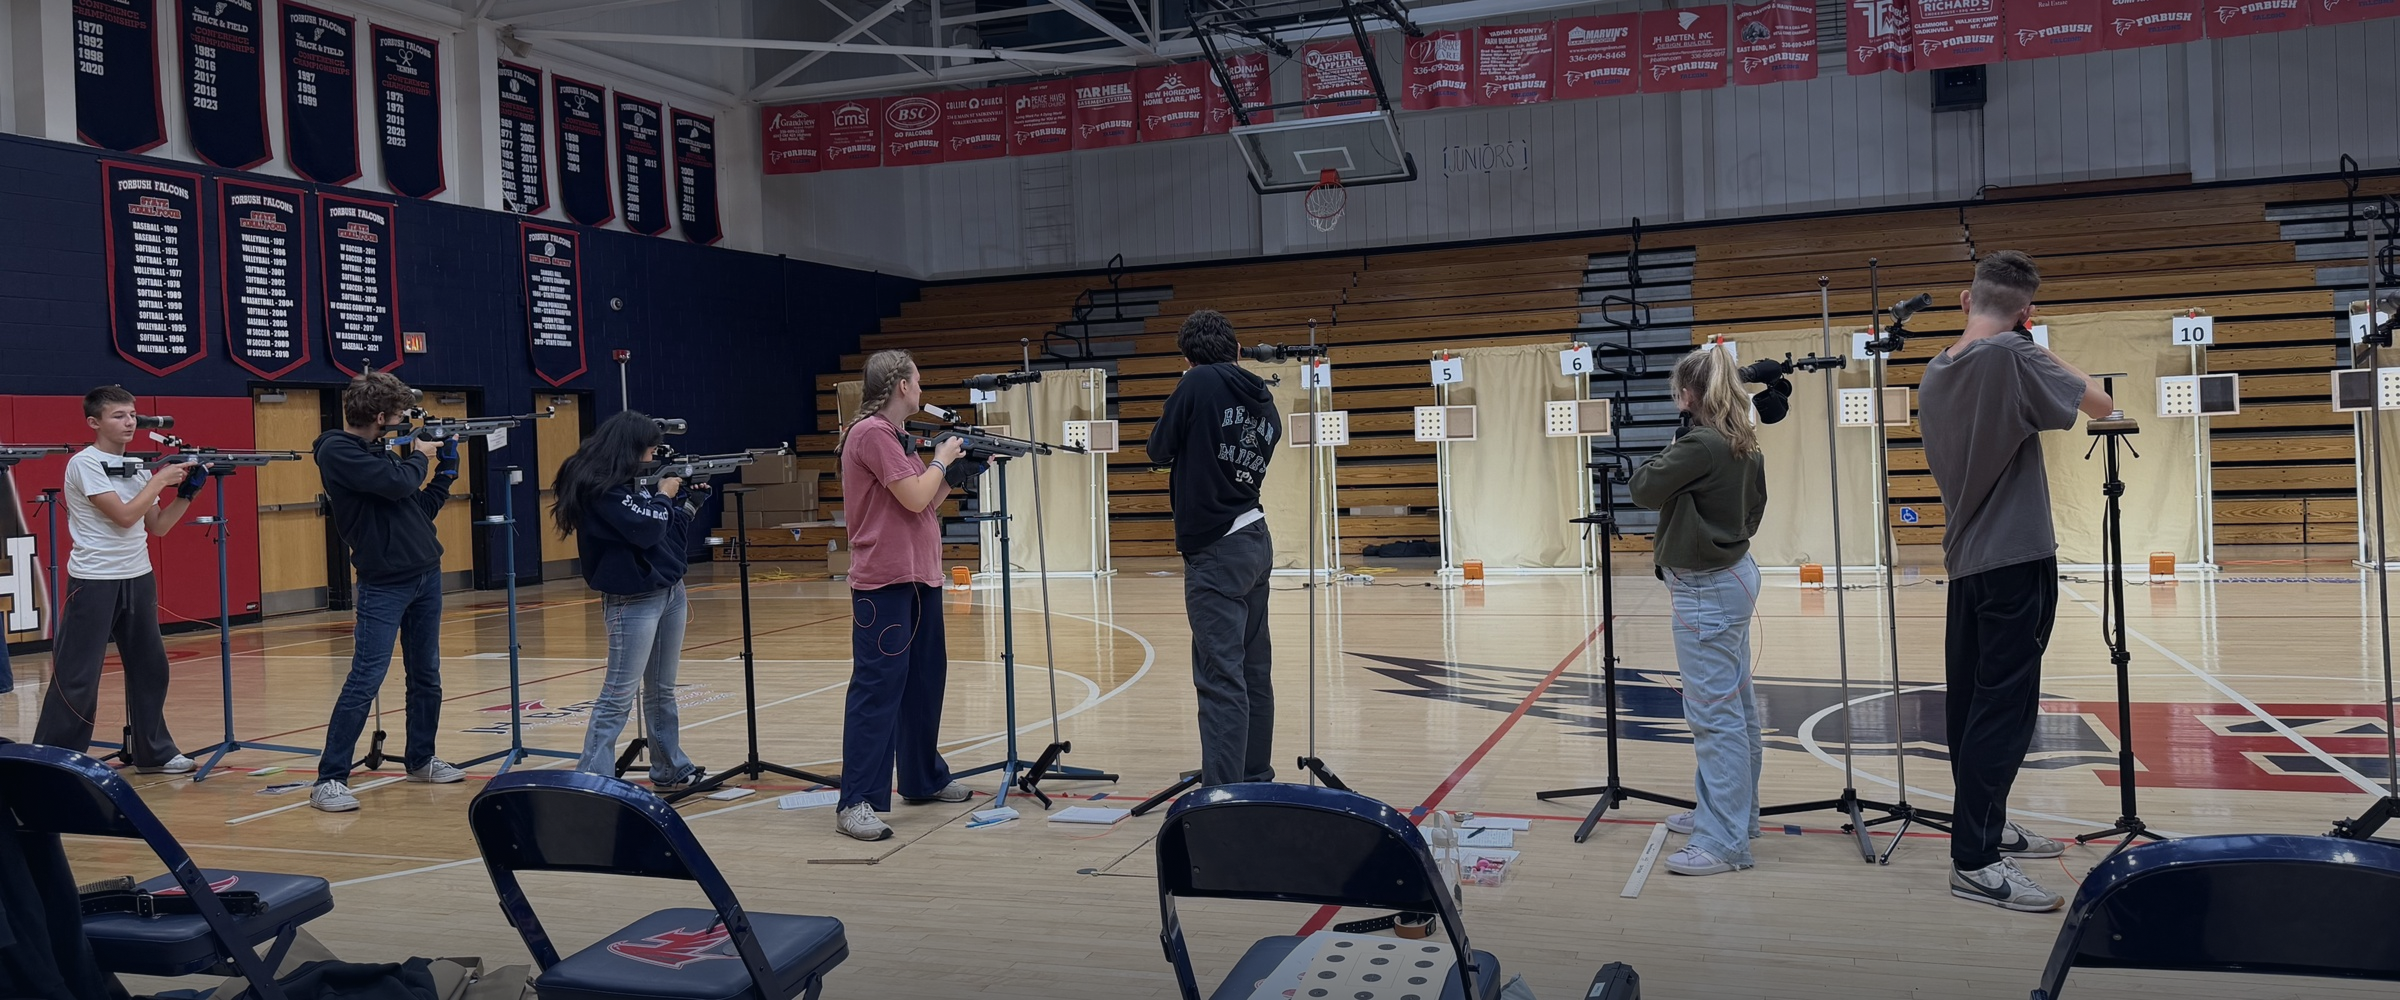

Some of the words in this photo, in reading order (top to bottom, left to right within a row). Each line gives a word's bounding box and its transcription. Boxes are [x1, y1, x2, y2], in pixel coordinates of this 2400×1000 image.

[79, 0, 139, 20] CONFERENCE
[1753, 4, 1771, 15] PAVING
[1776, 4, 1813, 14] MAINTENANCE
[2240, 0, 2298, 15] FORBUSH
[73, 6, 147, 30] CHAMPIONSHIPS
[192, 12, 218, 26] TRACK
[219, 20, 225, 28] &
[227, 21, 248, 33] FIELD
[1914, 21, 1948, 29] CLEMMONS
[1955, 16, 1998, 24] WALKERTOWN
[2136, 12, 2192, 27] FORBUSH
[2252, 12, 2286, 21] FALCONS
[77, 19, 103, 36] 1970
[290, 14, 317, 25] FORBUSH
[318, 17, 346, 37] FALCONS
[1915, 26, 1954, 35] YADKINVILLE
[2038, 24, 2093, 38] FORBUSH
[2148, 24, 2182, 33] FALCONS
[195, 26, 249, 45] CONFERENCE
[1519, 33, 1547, 43] INSURANCE
[1586, 27, 1628, 39] MARVIN'S
[78, 34, 103, 49] 1992
[191, 33, 255, 54] CHAMPIONSHIPS
[1652, 36, 1662, 45] JH
[1942, 35, 1994, 48] FORBUSH
[194, 44, 216, 59] 1983
[295, 38, 317, 51] TRACK
[323, 46, 344, 57] FIELD
[380, 38, 405, 49] FORBUSH
[406, 39, 432, 59] FALCONS
[1877, 41, 1912, 53] FORBUSH
[78, 47, 103, 63] 1998
[298, 51, 345, 67] CONFERENCE
[1308, 52, 1351, 66] WAGNER
[1569, 51, 1626, 62] 336-699-8468
[1762, 52, 1810, 65] FORBUSH
[80, 61, 104, 76] 2020
[194, 57, 216, 71] 2016
[293, 57, 350, 76] CHAMPIONSHIPS
[396, 64, 417, 75] TENNIS
[1413, 63, 1464, 74] 336-679-2034
[1671, 61, 1718, 74] FORBUSH
[194, 70, 216, 84] 2017
[297, 70, 316, 83] 1997
[1584, 68, 1631, 80] FORBUSH
[387, 73, 430, 89] CONFERENCE
[1428, 80, 1467, 92] FORBUSH
[1502, 81, 1547, 92] FORBUSH
[194, 83, 217, 97] 2018
[297, 82, 317, 95] 1998
[1076, 87, 1100, 99] TAR
[1102, 83, 1131, 95] HEEL
[1145, 91, 1160, 99] NEW
[1163, 87, 1200, 96] HORIZONS
[193, 96, 218, 111] 2023
[298, 94, 318, 107] 1999
[946, 101, 967, 110] COLLIDE
[981, 97, 1002, 107] CHURCH
[1016, 95, 1030, 114] ph
[1031, 95, 1047, 105] PEACE
[1049, 93, 1066, 102] HAVEN
[1078, 98, 1106, 107] BASEMENT
[1107, 95, 1132, 103] SYSTEMS
[1143, 98, 1163, 106] HOME
[1165, 95, 1187, 103] CARE,
[837, 114, 866, 126] cms
[899, 107, 927, 121] BSC
[1161, 112, 1200, 122] FORBUSH
[781, 118, 815, 127] Grandview
[1095, 120, 1132, 131] FORBUSH
[386, 125, 406, 137] 2020
[1030, 128, 1067, 138] FORBUSH
[386, 136, 407, 148] 2023
[905, 140, 939, 150] FORBUSH
[966, 134, 1001, 144] FORBUSH
[783, 149, 817, 158] FORBUSH
[842, 145, 876, 154] FORBUSH
[644, 159, 658, 169] 2015
[1449, 144, 1514, 173] JUNIORS
[118, 180, 152, 191] FORBUSH
[154, 181, 189, 199] FALCONS
[231, 195, 261, 205] FORBUSH
[263, 196, 293, 213] FALCONS
[157, 208, 181, 219] FOUR
[330, 207, 356, 217] FORBUSH
[358, 209, 385, 225] FALCONS
[132, 221, 160, 232] BASEBALL
[164, 225, 178, 234] 1969
[134, 233, 161, 243] BASEBALL
[165, 236, 177, 244] 1971
[241, 233, 270, 244] VOLLEYBALL
[135, 244, 161, 254] SOFTBALL
[242, 244, 270, 254] VOLLEYBALL
[136, 255, 162, 264] SOFTBALL
[133, 265, 165, 276] VOLLEYBALL
[136, 277, 163, 287] SOFTBALL
[137, 288, 163, 298] SOFTBALL
[138, 300, 163, 309] SOFTBALL
[139, 311, 164, 320] SOFTBALL
[137, 322, 167, 331] VOLLEYBALL
[140, 333, 164, 342] SOFTBALL
[2181, 327, 2205, 342] 10
[137, 344, 168, 353] VOLLEYBALL
[1572, 357, 1582, 371] 6
[1313, 373, 1320, 384] 4
[1443, 368, 1452, 381] 5
[1218, 443, 1266, 474] RAERS
